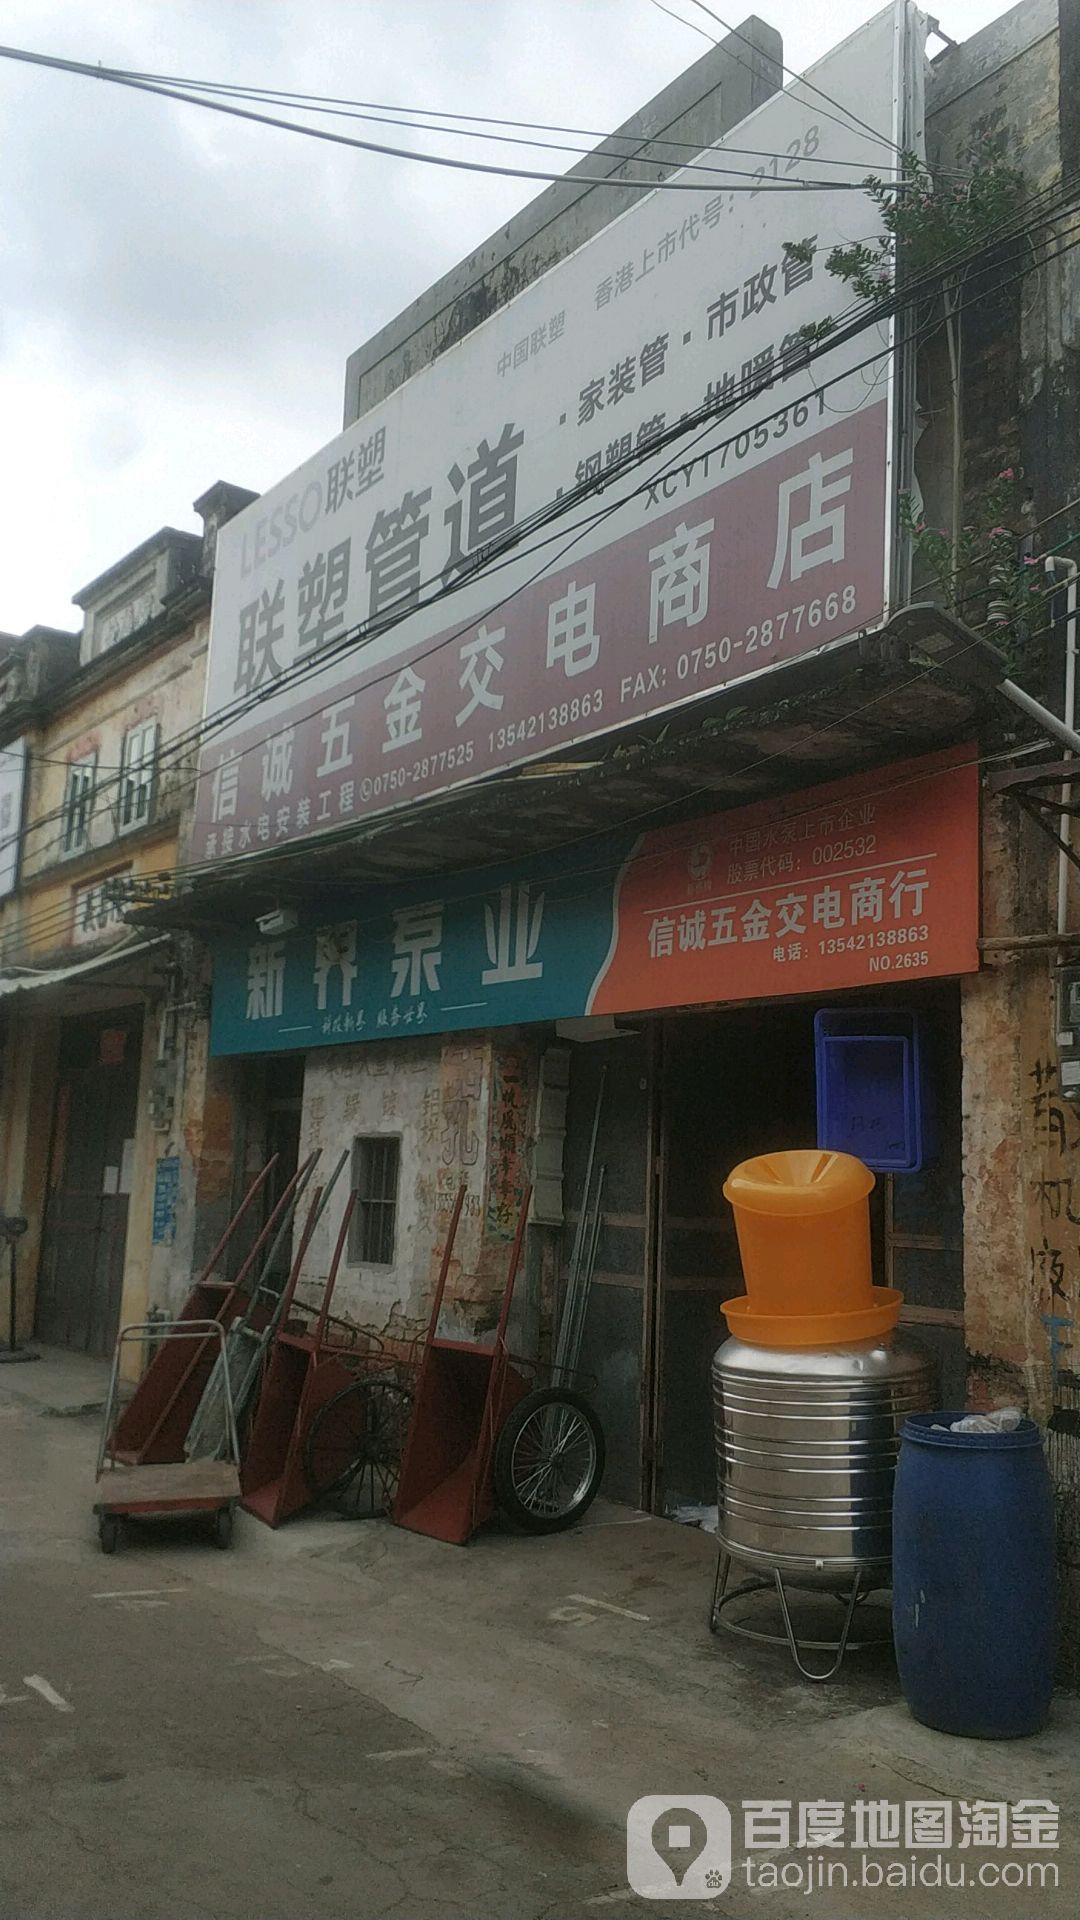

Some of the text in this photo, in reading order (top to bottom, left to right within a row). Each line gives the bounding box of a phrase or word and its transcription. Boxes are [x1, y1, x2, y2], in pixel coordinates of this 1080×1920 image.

[497, 310, 566, 378] 中国联塑
[234, 423, 525, 694] 联塑管道
[211, 448, 854, 823] 信诚五金交电商店
[488, 689, 604, 752] 13542138863
[620, 663, 667, 704] FAX:
[677, 585, 857, 679] 0750-2877668
[729, 804, 876, 855] 中国水泵上市企业
[812, 835, 877, 866] 002532
[246, 882, 545, 1020] 新界泵业
[648, 868, 930, 958] 信诚五金交电商行
[818, 925, 929, 956] 13542138863
[869, 951, 929, 973] NO.2635
